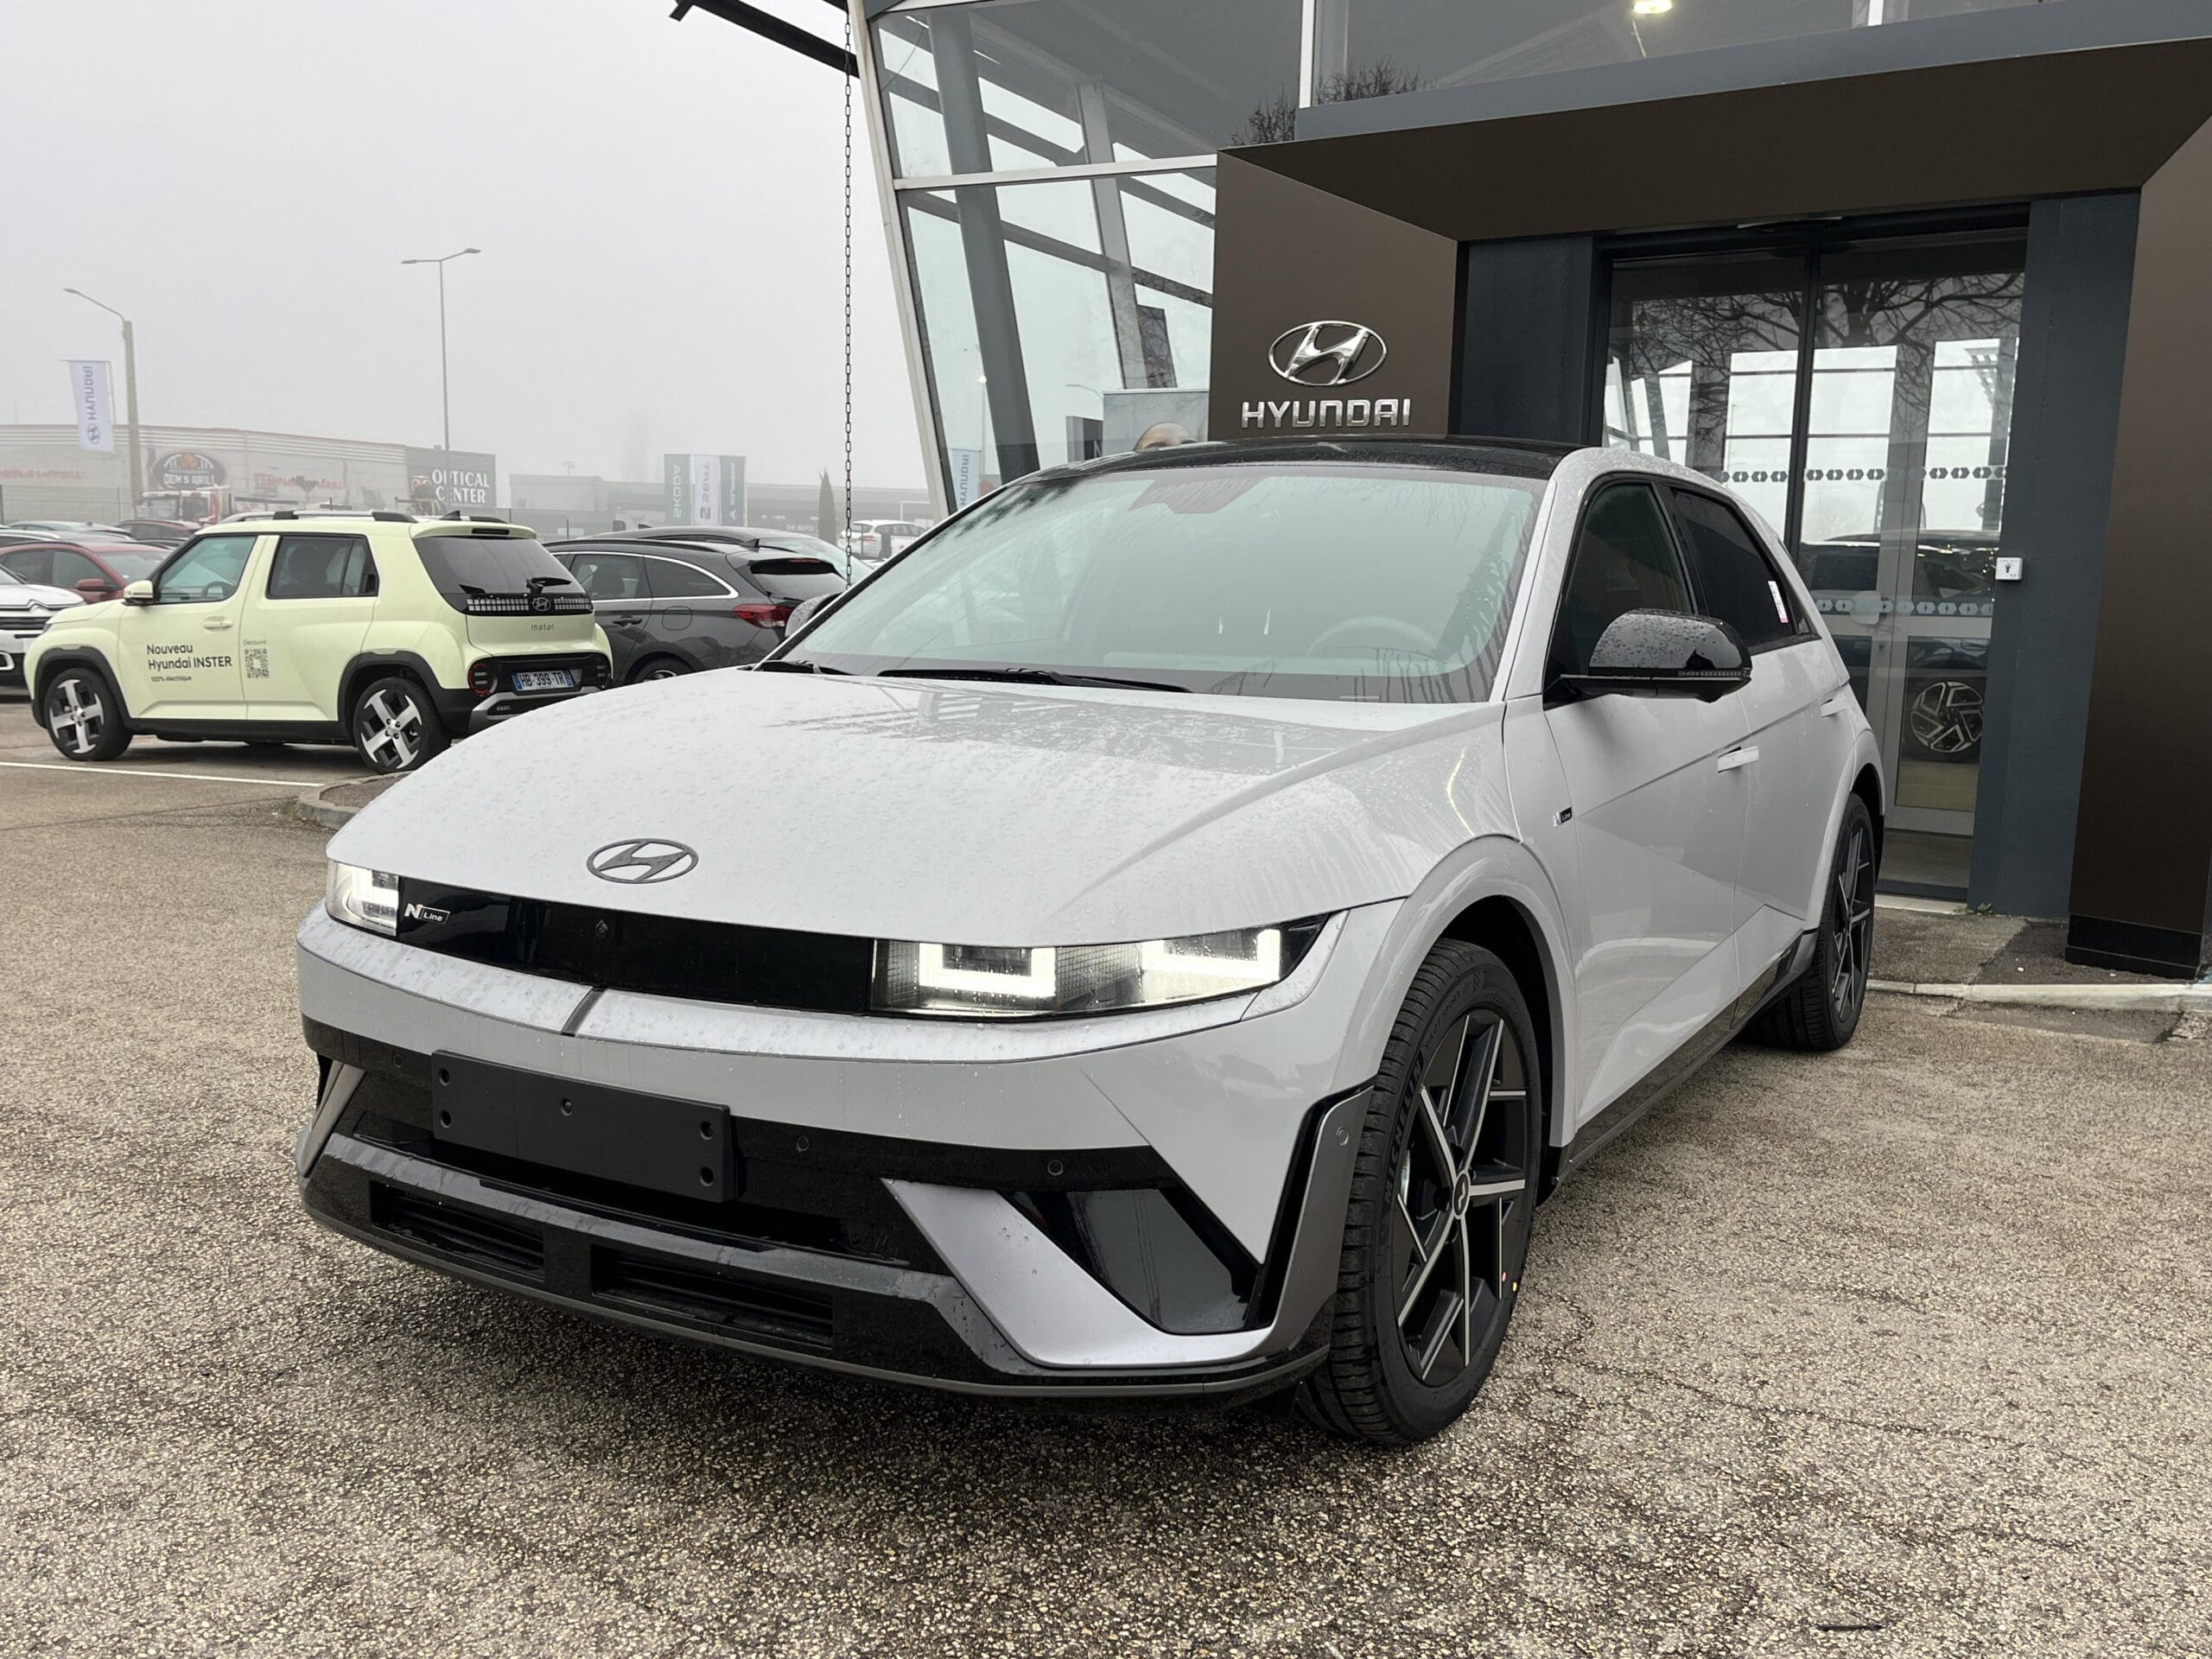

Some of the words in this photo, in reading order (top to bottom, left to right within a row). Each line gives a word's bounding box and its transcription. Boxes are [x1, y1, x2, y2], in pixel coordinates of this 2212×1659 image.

[1241, 398, 1411, 429] HYUNDAI
[435, 486, 486, 504] CNTER
[147, 644, 194, 655] Nouveau
[148, 657, 192, 671] Hyundai
[194, 656, 232, 668] INSTER
[404, 903, 423, 919] N
[423, 912, 443, 922] Line
[1384, 1059, 1421, 1204] MICHELIN
